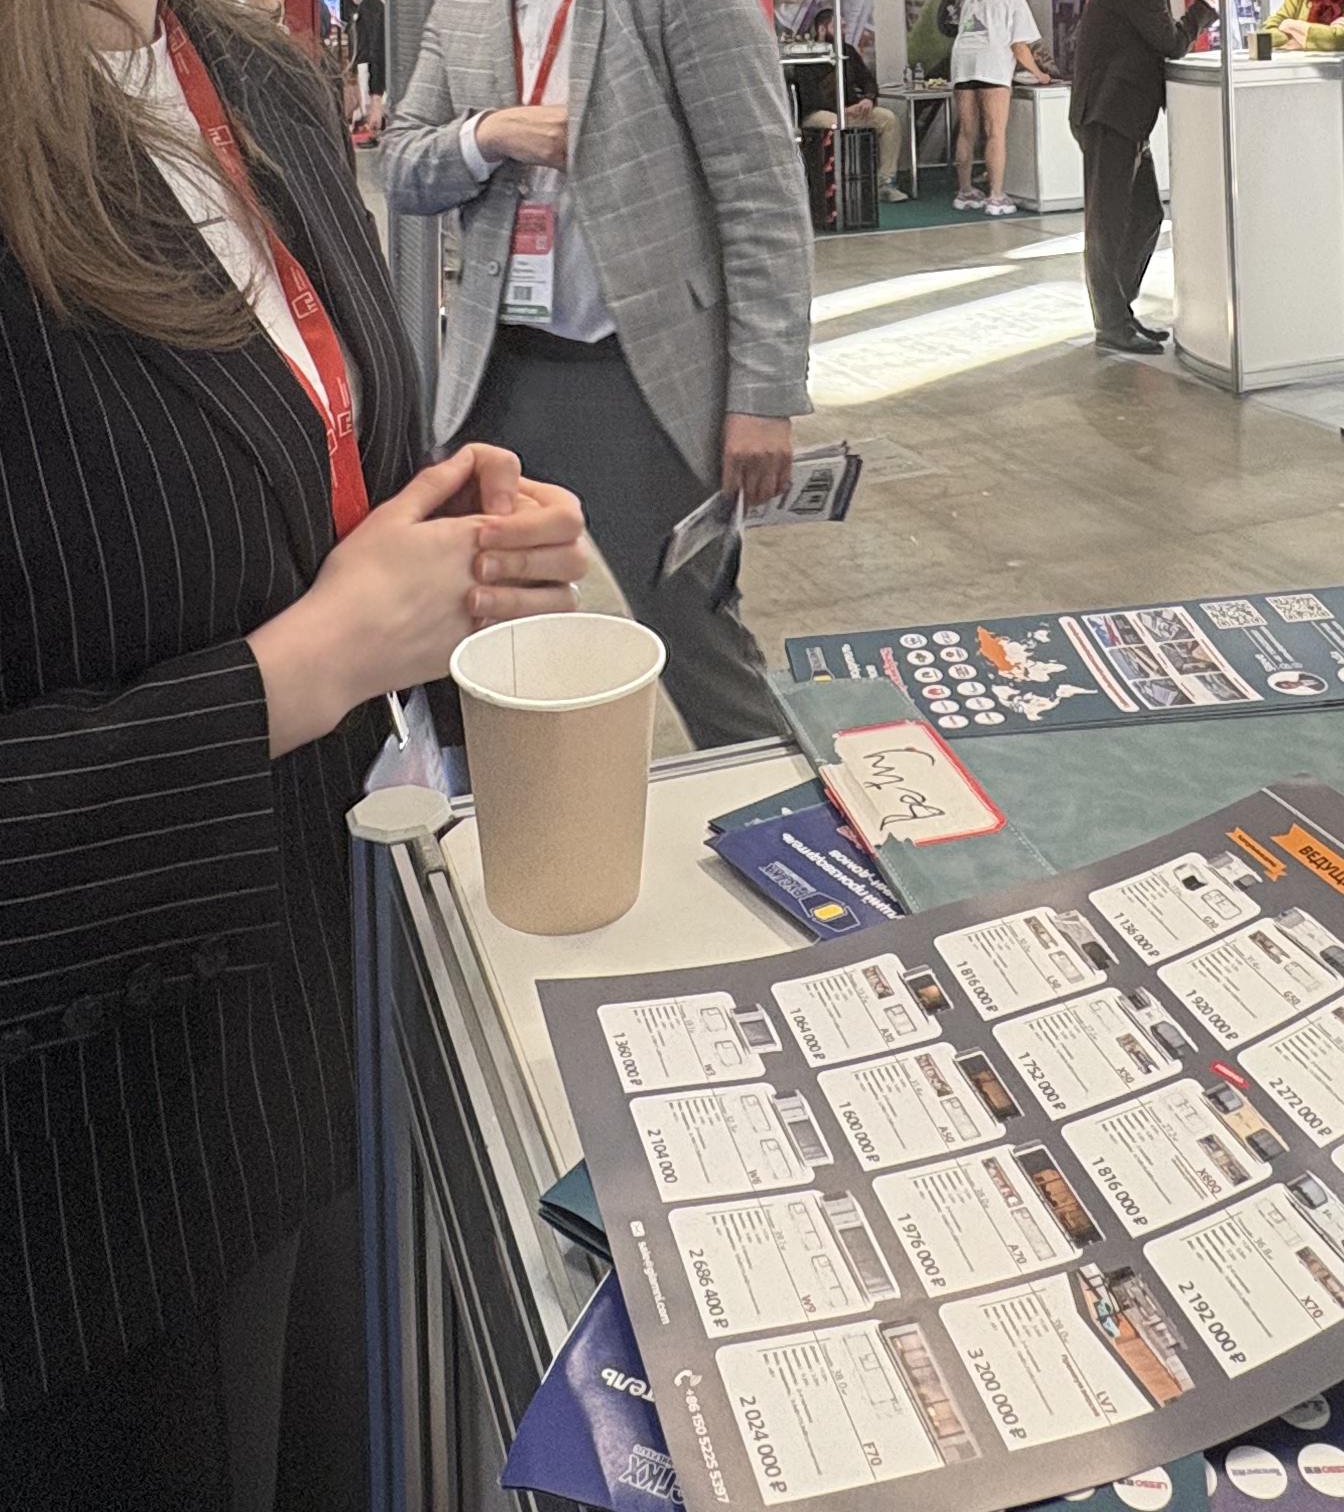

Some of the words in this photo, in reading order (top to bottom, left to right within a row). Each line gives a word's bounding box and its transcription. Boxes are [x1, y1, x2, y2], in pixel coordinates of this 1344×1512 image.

[1113, 912, 1125, 920] 1
[1132, 934, 1154, 951] 000
[956, 960, 968, 968] 1
[973, 986, 993, 1005] 000
[1185, 989, 1197, 998] 1
[1191, 996, 1214, 1016] 920
[1208, 1014, 1231, 1034] 000
[789, 1007, 802, 1015] 1
[802, 1033, 822, 1053] 000
[615, 1040, 633, 1058] 360
[1018, 1051, 1031, 1060] 1
[622, 1059, 640, 1078] 000
[1023, 1059, 1046, 1082] 752
[1037, 1080, 1060, 1103] 000
[1268, 1077, 1284, 1089] 2
[1276, 1085, 1304, 1109] 272
[1297, 1106, 1324, 1129] 000
[838, 1101, 852, 1109] 1
[647, 1128, 662, 1137] 2
[842, 1110, 864, 1131] 600
[651, 1137, 670, 1160] 104
[854, 1131, 876, 1153] 000
[658, 1160, 678, 1184] 000
[1092, 1156, 1105, 1166] 1
[1097, 1166, 1123, 1191] 816
[1195, 1164, 1224, 1197] X60Q
[1115, 1190, 1141, 1216] 000
[897, 1212, 912, 1222] 1
[902, 1223, 926, 1249] 976
[688, 1248, 705, 1259] 2
[916, 1249, 941, 1276] 000
[1006, 1239, 1029, 1268] A70
[692, 1260, 715, 1287] 686
[704, 1288, 725, 1316] 400
[1299, 1292, 1326, 1321] X70
[1177, 1280, 1195, 1294] 2
[1188, 1292, 1216, 1323] 192
[1207, 1321, 1237, 1353] 000
[967, 1347, 985, 1360] 3
[973, 1361, 1001, 1392] 200
[739, 1395, 757, 1408] 2
[991, 1393, 1020, 1425] 000
[1095, 1388, 1119, 1418] LV7
[691, 1412, 708, 1436] 150
[744, 1409, 770, 1442] 024
[698, 1436, 719, 1470] 5225
[756, 1443, 782, 1478] 000
[860, 1438, 886, 1469] F70
[708, 1470, 730, 1504] 5397
